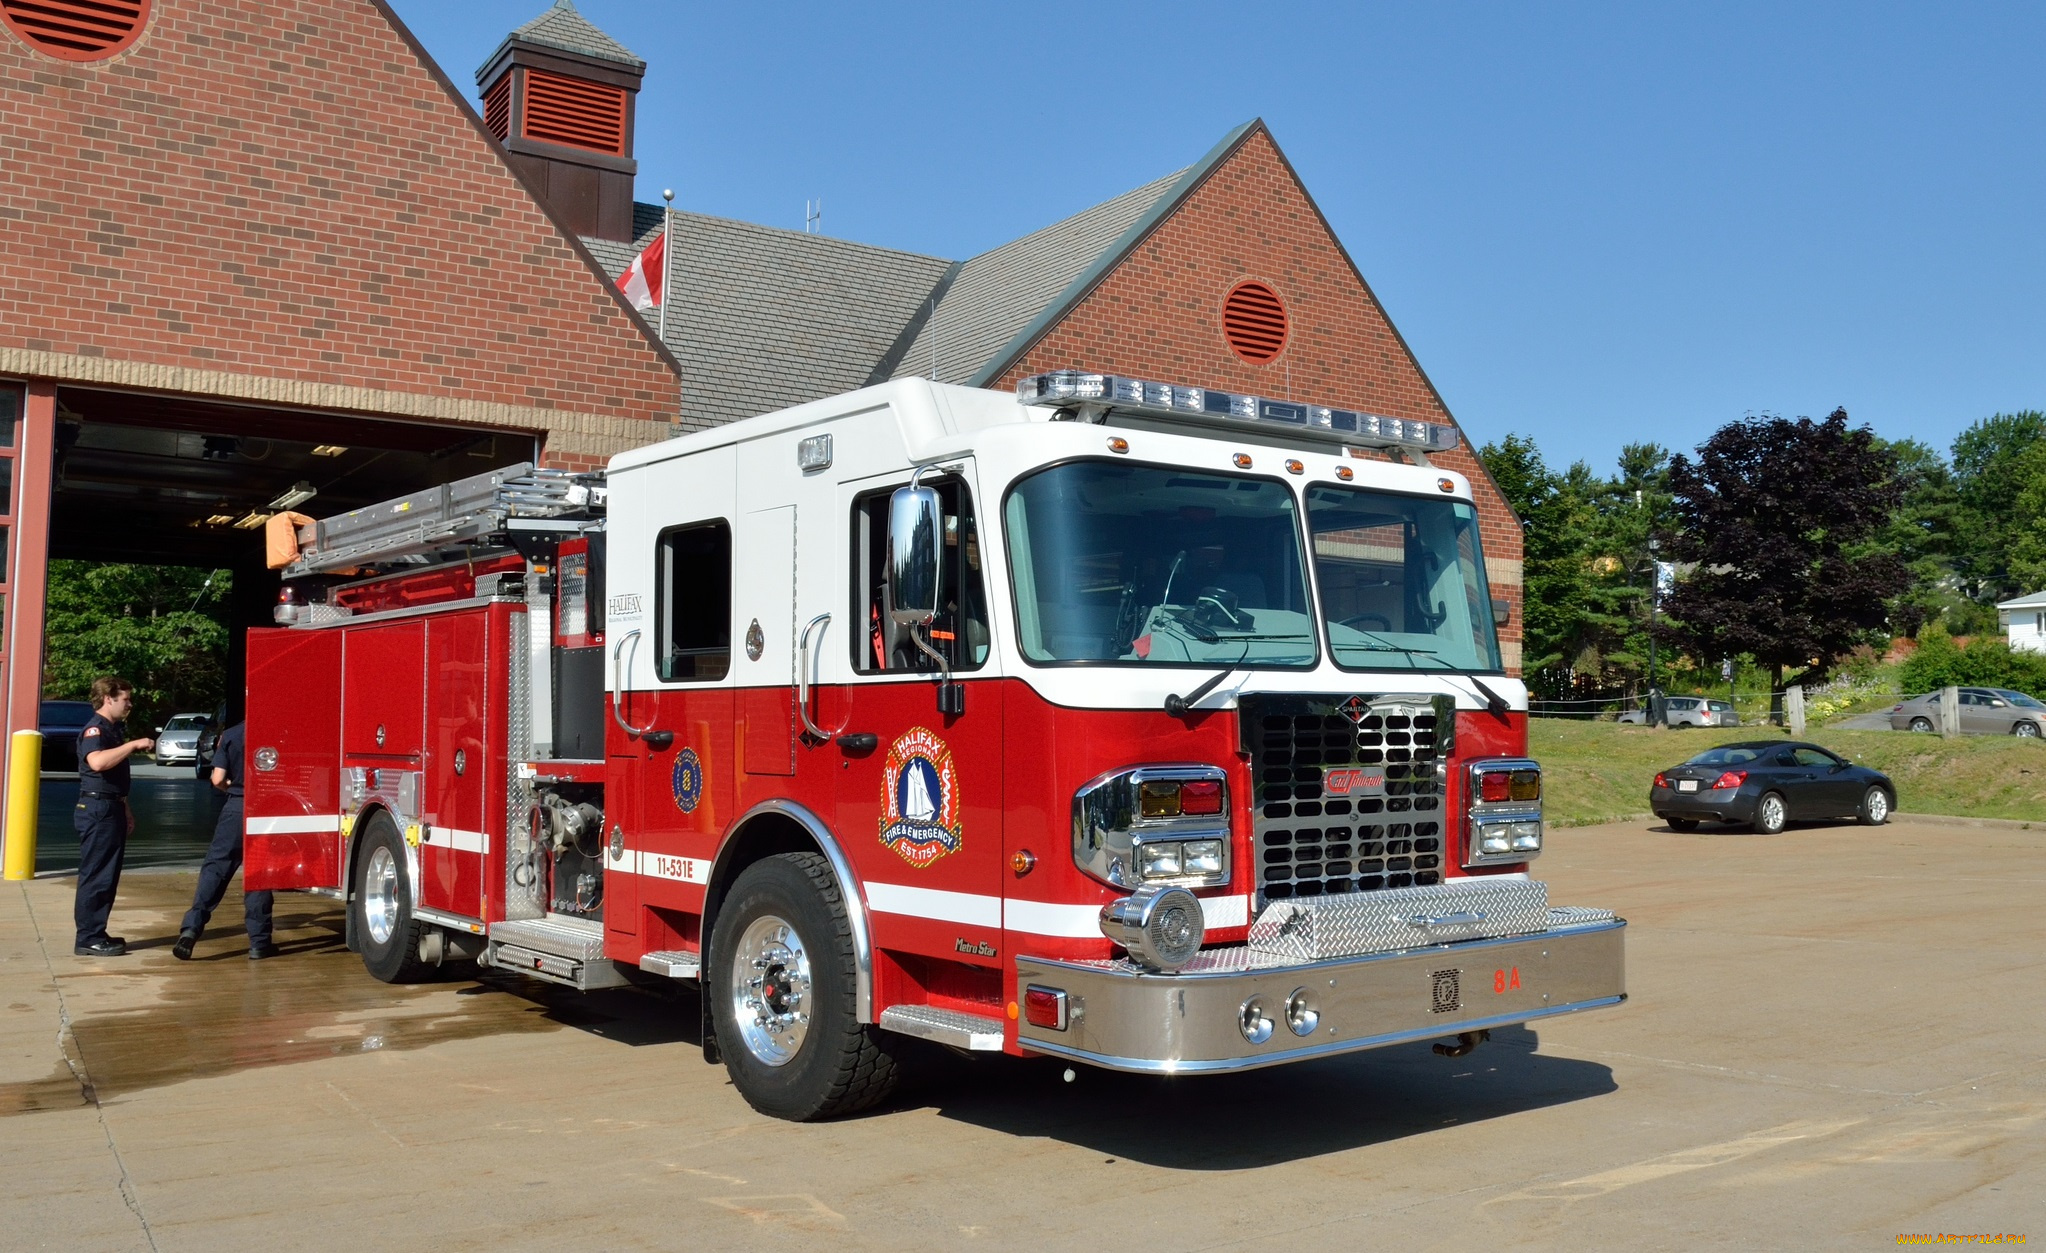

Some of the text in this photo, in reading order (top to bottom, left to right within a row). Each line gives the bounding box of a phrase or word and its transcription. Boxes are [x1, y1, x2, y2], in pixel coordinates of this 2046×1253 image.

[609, 595, 642, 615] HALIFAX
[897, 732, 940, 754] HALIFAX
[901, 745, 935, 761] REGIONAL
[682, 769, 692, 791] 8
[886, 825, 900, 841] FIRE
[907, 828, 952, 845] EMERGENCY
[657, 857, 693, 879] 11-531E
[955, 938, 996, 956] Metro Star
[1494, 966, 1520, 993] 8 A
